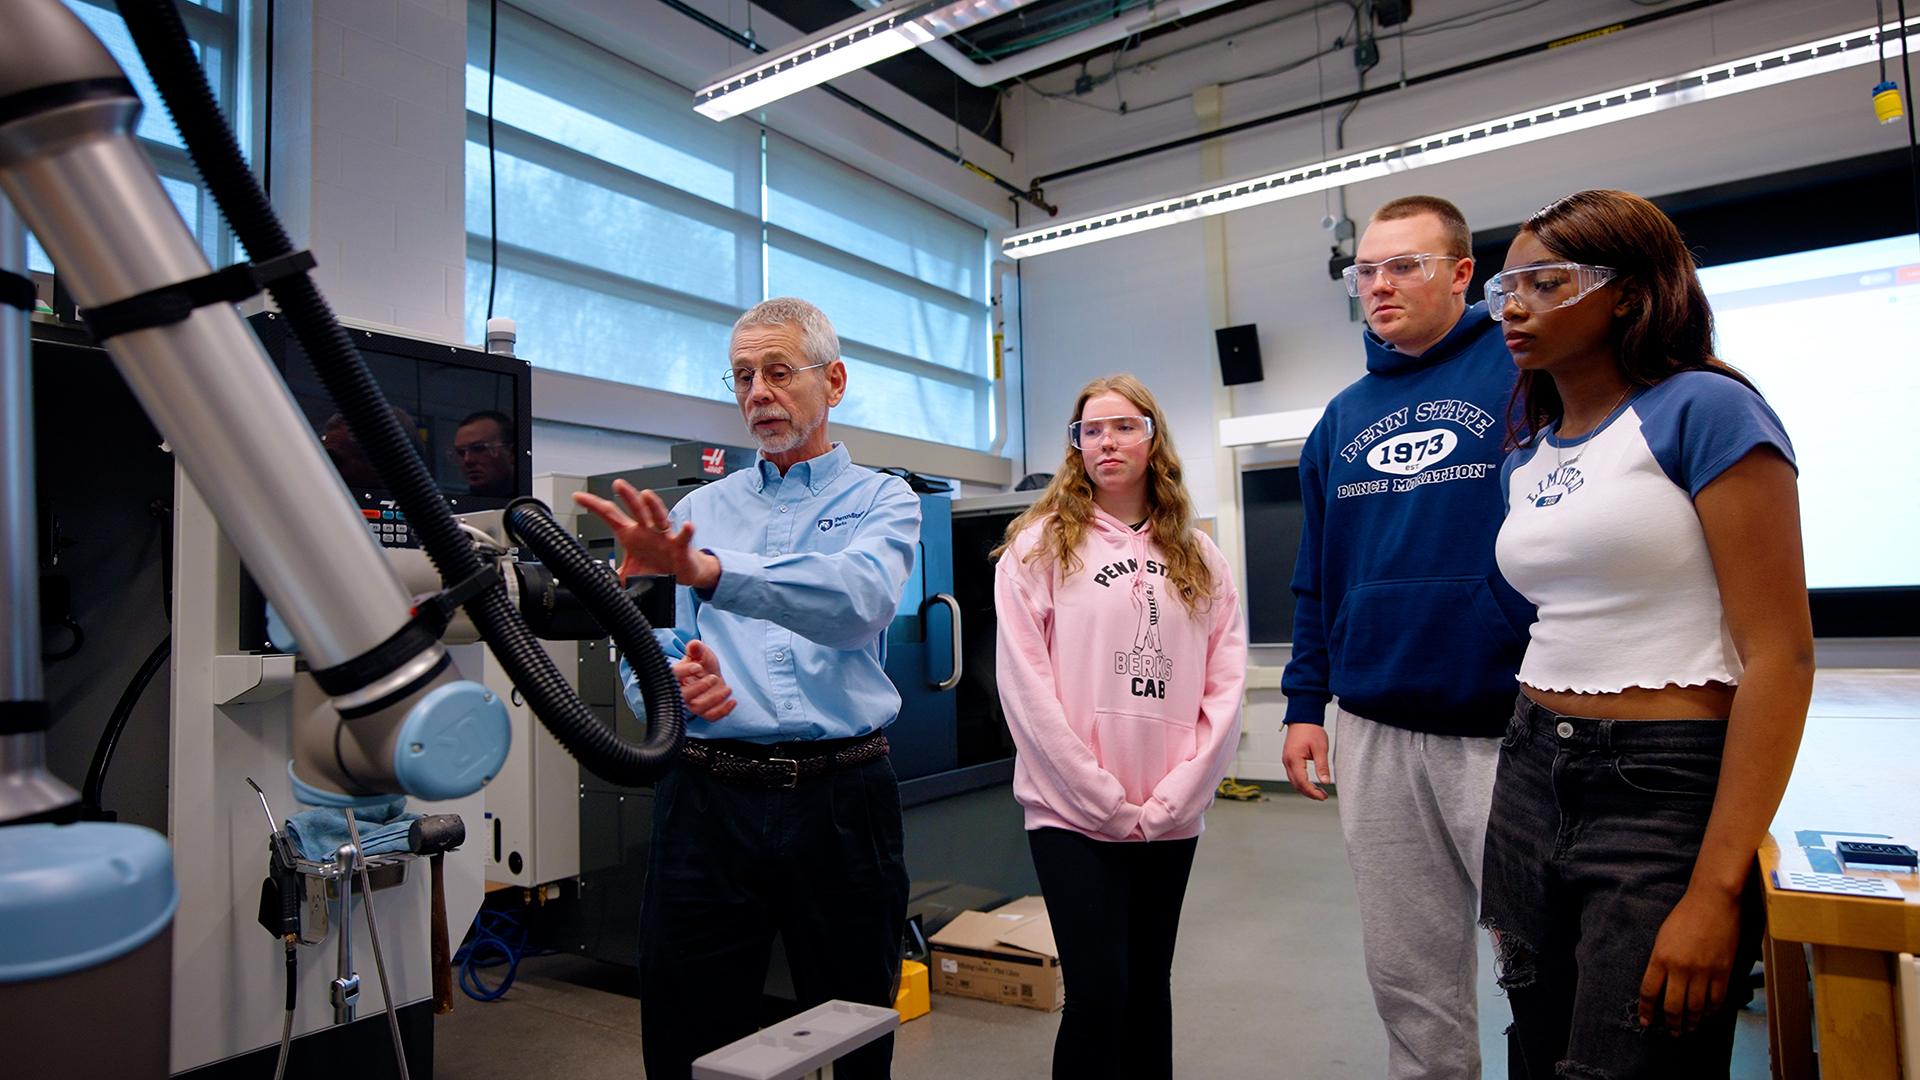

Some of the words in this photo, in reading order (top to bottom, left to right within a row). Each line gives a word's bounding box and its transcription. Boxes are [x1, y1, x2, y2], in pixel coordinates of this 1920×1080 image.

[1340, 406, 1409, 463] PENN
[1415, 399, 1495, 436] STATE
[1380, 433, 1445, 465] 1973
[1337, 479, 1389, 499] DANCE
[1526, 467, 1584, 504] LIMITED
[1093, 558, 1139, 588] PENN
[1114, 651, 1173, 681] BERKS
[1131, 677, 1165, 699] CAB
